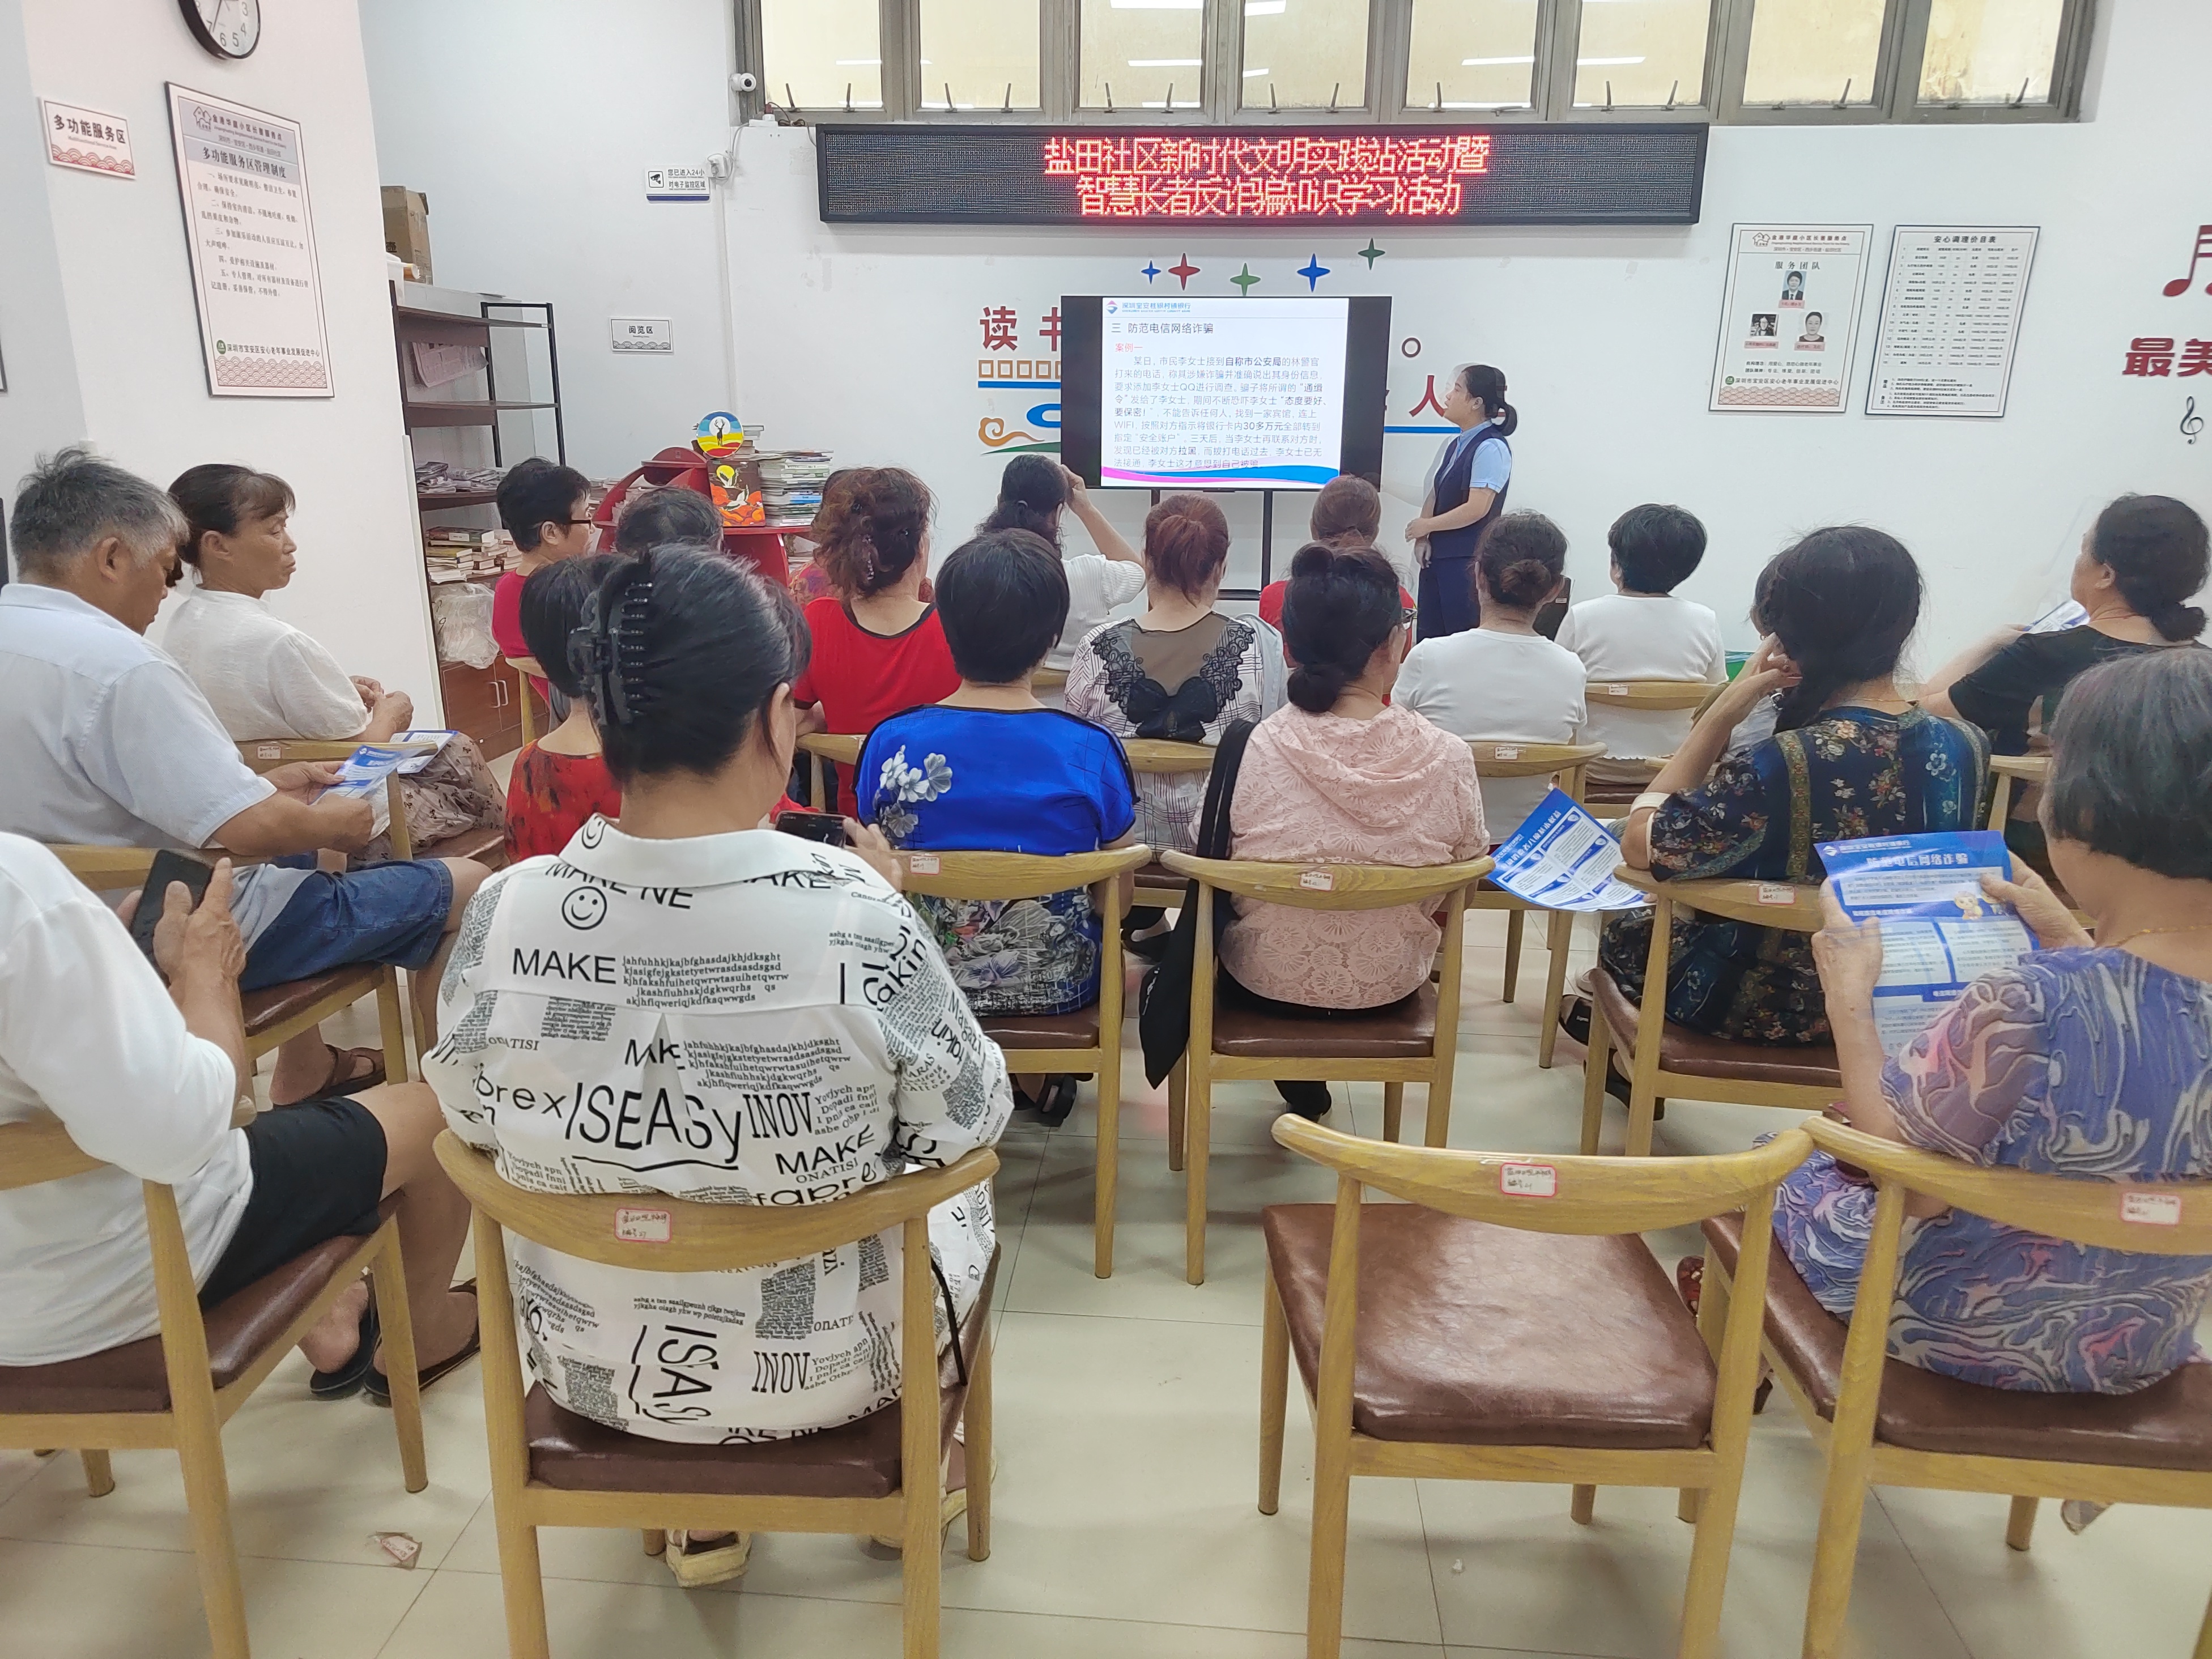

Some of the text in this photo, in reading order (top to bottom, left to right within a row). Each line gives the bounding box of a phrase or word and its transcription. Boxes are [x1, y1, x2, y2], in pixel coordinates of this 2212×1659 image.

[54, 114, 126, 144] 多功能服务区
[202, 147, 287, 178] 多功能服务区管理制度
[668, 169, 705, 177] 您已进入24小
[1775, 261, 1820, 270] 服务团队
[628, 325, 653, 335] 阅览区
[1111, 323, 1214, 334] 三 防范电信网络诈骗
[1115, 343, 1143, 352] 案例一
[513, 948, 616, 985] MAKE
[743, 1092, 813, 1139] INOV
[775, 1124, 875, 1175] MAKE
[752, 1351, 811, 1394] INOV
